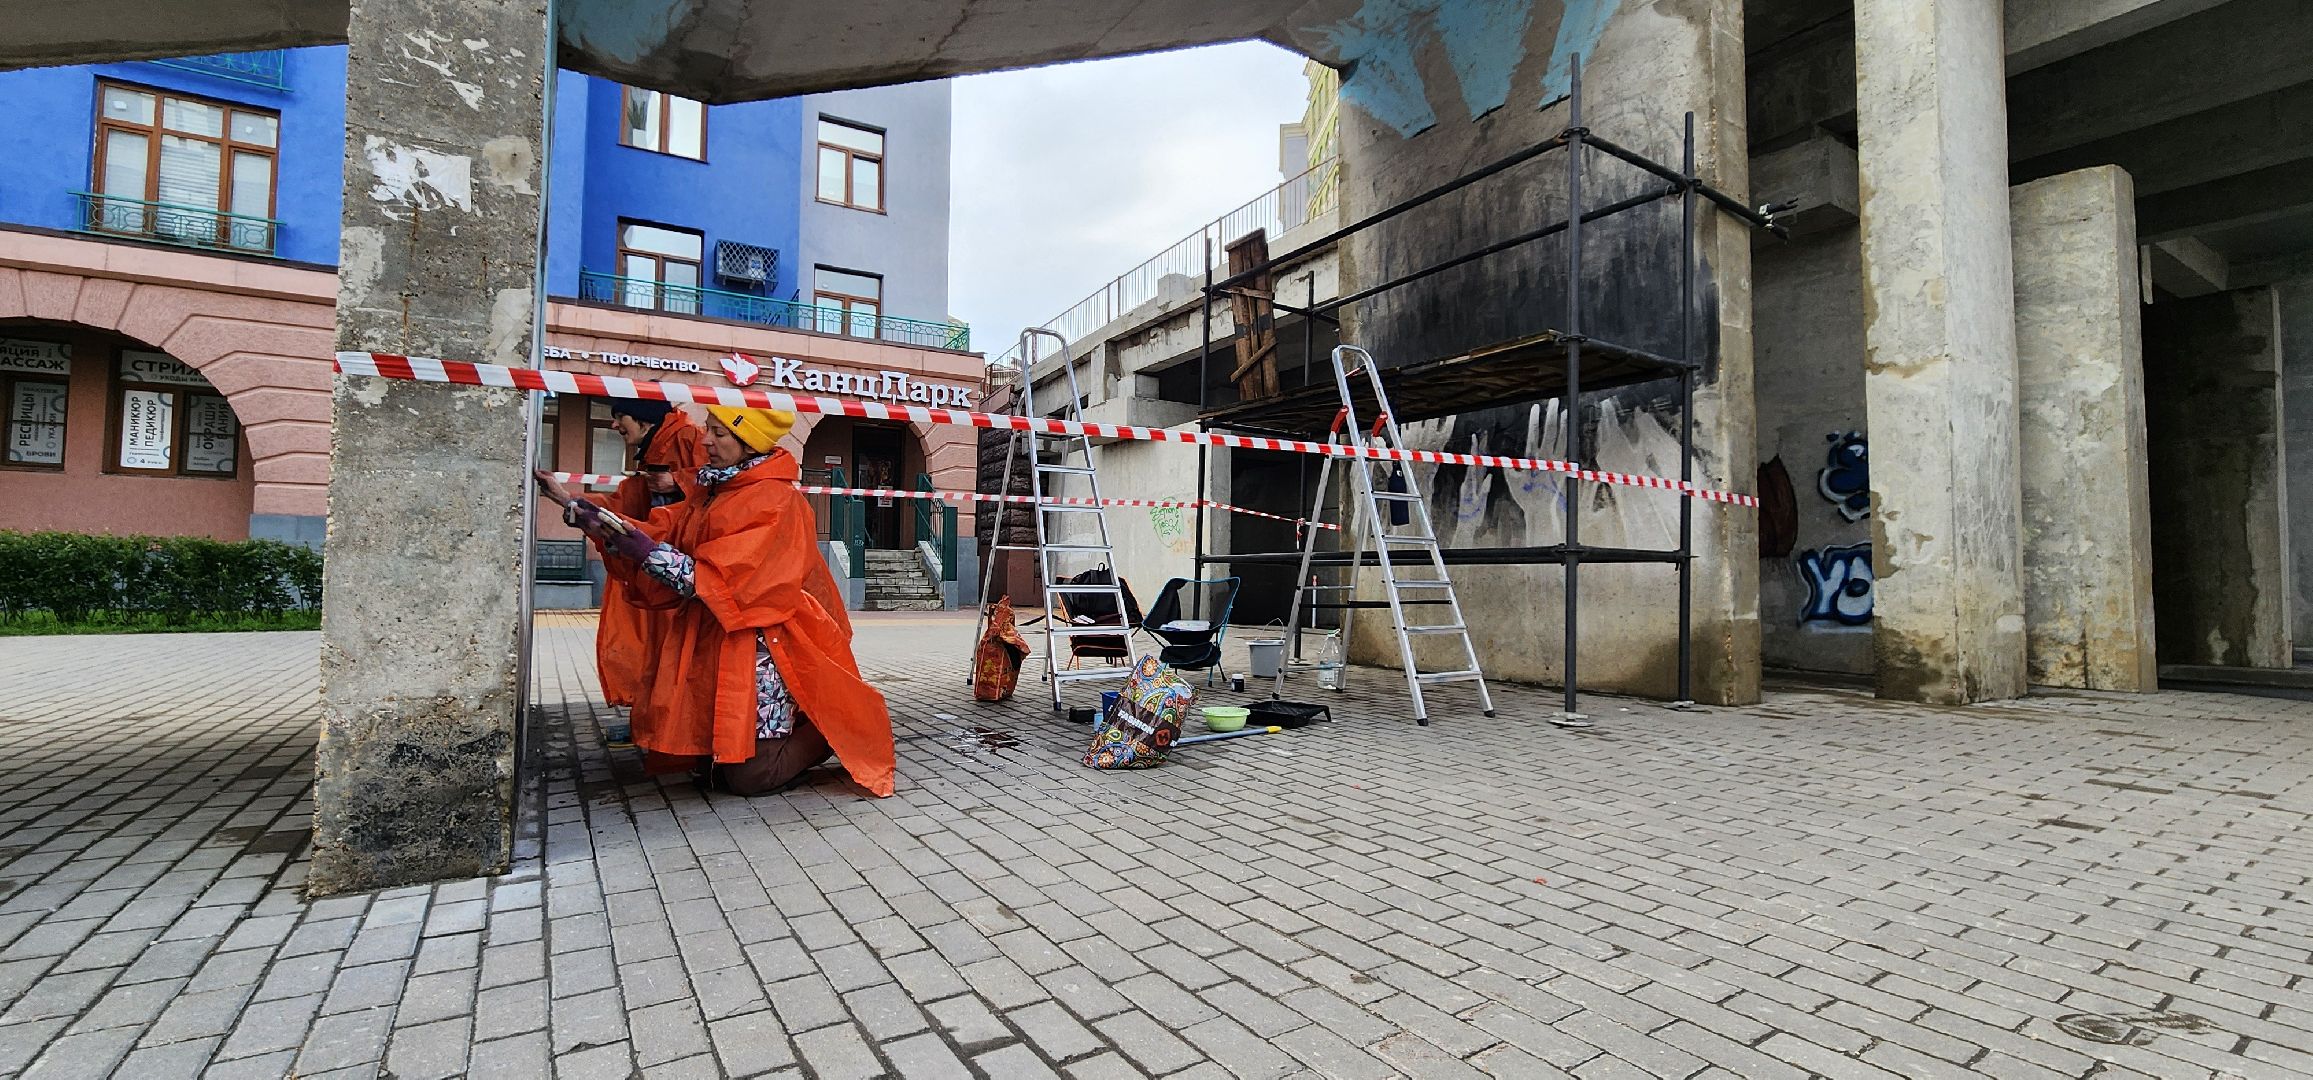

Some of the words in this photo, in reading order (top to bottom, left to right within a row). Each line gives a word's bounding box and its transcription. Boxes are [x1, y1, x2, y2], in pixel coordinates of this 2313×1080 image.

[1, 357, 64, 371] АССАЖ
[600, 352, 700, 373] ТВОРЧЕСТВО
[771, 356, 973, 409] КанцПарк
[19, 393, 36, 446] РЕСНИЦЫ
[129, 396, 142, 446] МАНИКЮР
[144, 399, 158, 447] ПЕДИКЮР
[203, 402, 216, 450] ОКРАШИ
[1117, 709, 1155, 735] FASHION
